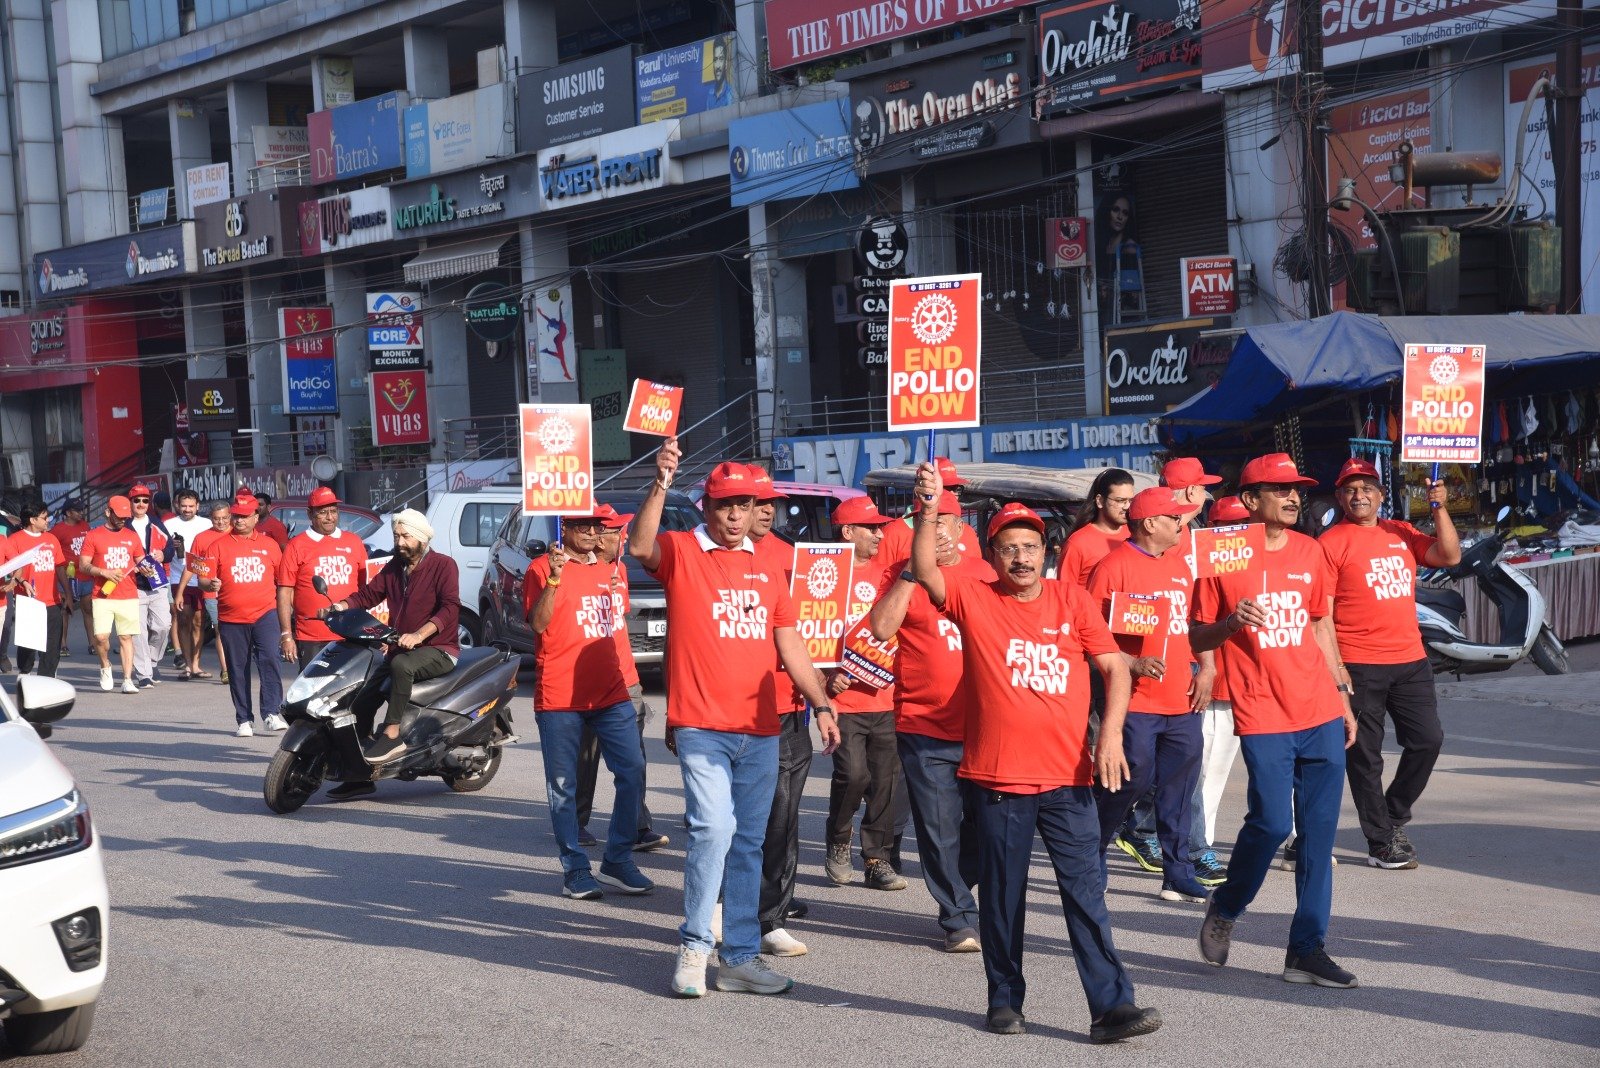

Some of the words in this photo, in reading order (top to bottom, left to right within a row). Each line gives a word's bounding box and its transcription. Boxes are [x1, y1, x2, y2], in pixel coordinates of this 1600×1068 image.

[787, 19, 831, 59] THE
[836, 0, 908, 46] TIMES
[1454, 18, 1489, 34] Branch
[1042, 12, 1131, 78] Orchid
[639, 55, 660, 76] Parul
[664, 45, 700, 68] University
[543, 66, 605, 105] SAMSUNG
[662, 70, 679, 83] Gujarat
[885, 100, 919, 135] The
[922, 91, 967, 127] Oven
[972, 72, 1020, 113] Chef
[546, 108, 577, 126] Customer
[579, 100, 604, 119] Service
[1370, 105, 1403, 125] ICICI
[1406, 101, 1432, 117] Ban
[442, 121, 455, 139] BFC
[1369, 128, 1401, 147] Capital
[1404, 125, 1430, 140] Gains
[317, 147, 333, 179] Dr
[336, 136, 378, 174] Batra's
[751, 146, 785, 173] Thomas
[787, 141, 809, 168] Cook
[188, 170, 204, 185] FOR
[206, 166, 227, 181] RENT
[540, 163, 598, 200] WATER
[600, 149, 662, 188] FRONT
[193, 188, 218, 200] CONTACT
[456, 208, 470, 219] TASTE
[471, 206, 481, 217] THE
[481, 201, 502, 214] ORIGINAL
[203, 248, 217, 267] The
[217, 243, 241, 265] Bread
[241, 235, 268, 260] Basket
[138, 249, 178, 275] Domino's
[876, 259, 896, 269] TOC
[50, 268, 88, 292] Domino's
[862, 279, 875, 288] The
[1190, 272, 1235, 294] ATM
[373, 325, 421, 345] FOREX
[867, 321, 887, 334] live
[375, 357, 420, 365] EXCHANGE
[382, 350, 411, 358] MONEY
[905, 345, 963, 372] END
[1106, 347, 1188, 389] Orchid
[290, 377, 331, 390] IndiGo
[893, 368, 974, 396] POLIO
[593, 393, 619, 408] PICK
[648, 394, 671, 410] END
[1421, 385, 1466, 402] END
[640, 404, 673, 422] POLIO
[900, 392, 965, 418] NOW
[1411, 400, 1474, 419] POLIO
[381, 412, 422, 437] vyas
[641, 417, 667, 433] NOW
[1417, 417, 1467, 434] NOW
[991, 431, 1012, 453] AIR
[1014, 428, 1069, 452] TICKETS
[1081, 424, 1121, 448] TOUR
[1422, 437, 1455, 447] October
[1408, 449, 1436, 458] WORLD
[1436, 449, 1460, 458] POLIO
[1460, 449, 1475, 458] DAY
[535, 455, 580, 473] END
[182, 469, 204, 501] Cake
[204, 466, 231, 501] Studio
[526, 472, 589, 490] POLIO
[533, 490, 583, 507] NOW
[107, 546, 128, 555] END
[1215, 537, 1247, 552] END
[103, 553, 130, 563] POLIO
[235, 556, 261, 567] END
[318, 555, 347, 567] END
[1209, 546, 1254, 564] POLIO
[1370, 555, 1405, 573] END
[34, 563, 55, 572] NOW
[106, 561, 128, 570] NOW
[190, 562, 210, 573] POLIO
[230, 564, 266, 576] POLIO
[314, 564, 353, 577] POLIO
[1214, 559, 1249, 575] NOW
[234, 573, 263, 584] NOW
[1365, 568, 1412, 588] POLIO
[718, 588, 761, 608] END
[1374, 582, 1412, 600] NOW
[581, 595, 611, 611] END
[1129, 603, 1155, 616] END
[1256, 590, 1303, 612] END
[712, 602, 768, 624] POLIO
[800, 600, 838, 621] END
[1123, 612, 1160, 626] POLIO
[719, 620, 767, 641] NOW
[1125, 623, 1155, 635] NOW
[1257, 627, 1304, 650] NOW
[804, 638, 839, 659] OW
[851, 640, 895, 668] NOW
[1009, 638, 1059, 663] END
[849, 652, 878, 676] October
[855, 666, 874, 682] POLIO
[873, 675, 888, 689] DAY
[1011, 667, 1068, 694] NOW
